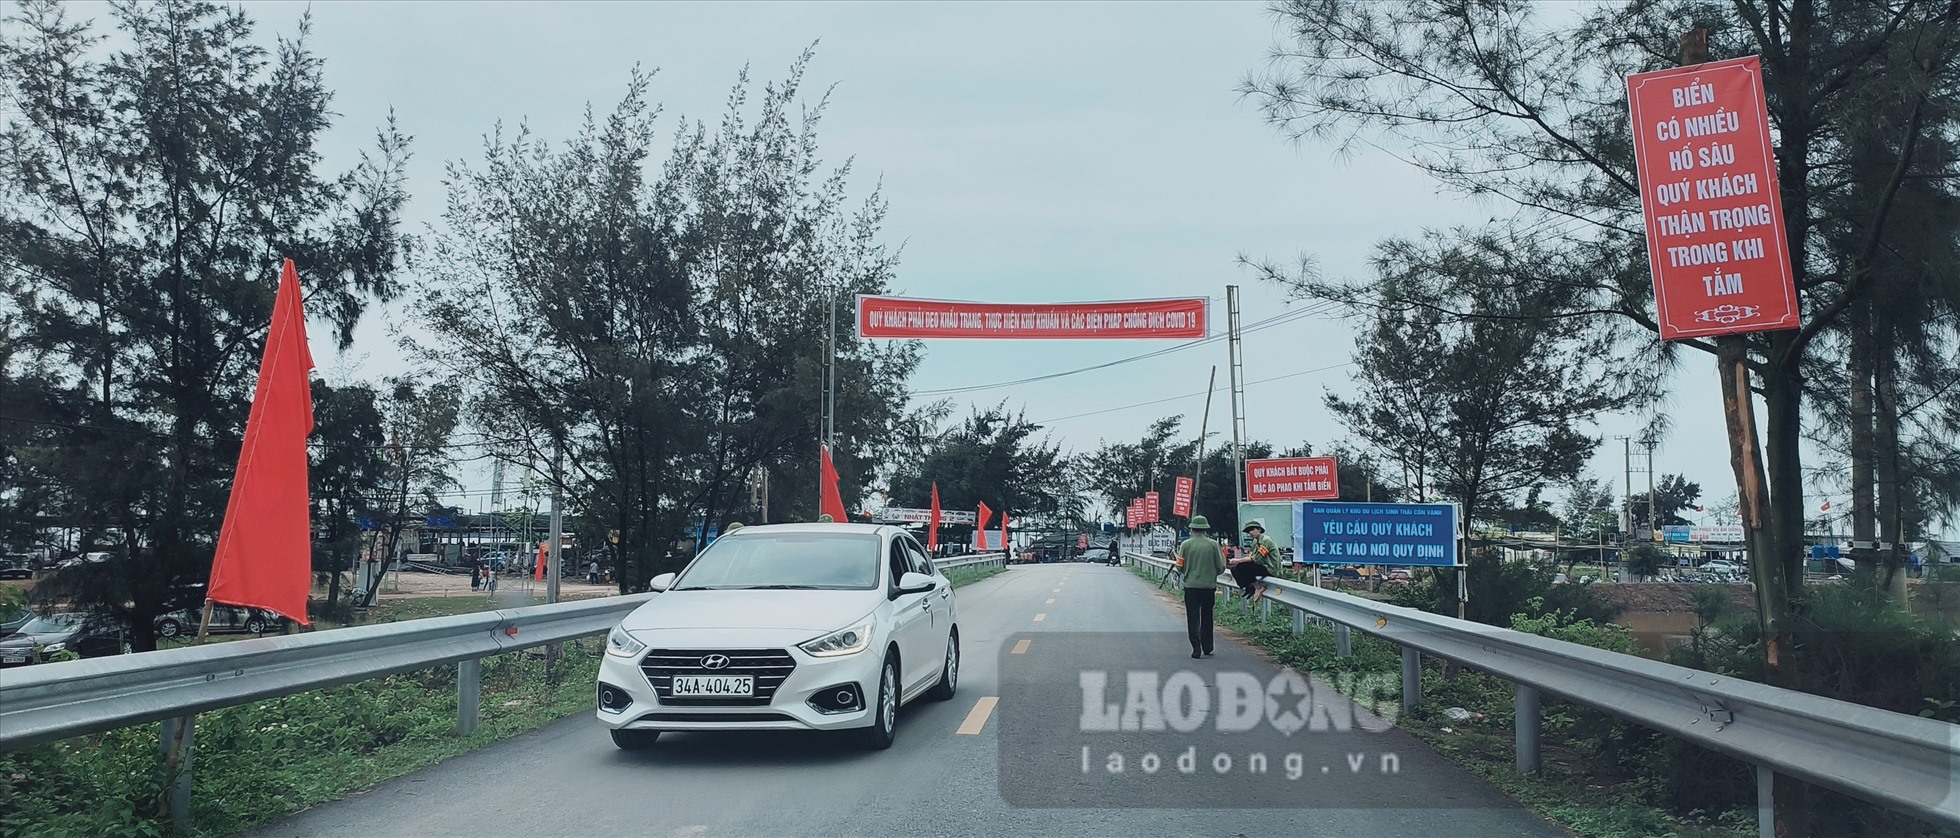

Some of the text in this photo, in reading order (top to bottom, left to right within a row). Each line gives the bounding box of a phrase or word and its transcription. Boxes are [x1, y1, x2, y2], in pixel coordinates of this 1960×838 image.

[1672, 76, 1715, 109] BIỂN
[1656, 106, 1740, 142] CÓ NHIỀU
[1669, 141, 1736, 172] HỐ SÂU
[1656, 172, 1758, 207] QUÝ KHÁCH
[1657, 203, 1772, 239] THẬN TRỌNG
[1668, 237, 1765, 268] TRONG KHI
[1702, 266, 1744, 297] TẮM
[869, 308, 883, 329] QUÝ
[884, 308, 907, 328] KHÁCH
[907, 306, 925, 328] PHẢI
[940, 306, 959, 328] KHẨU
[960, 312, 984, 330] TRANG,
[984, 310, 1003, 332] THỰC
[1003, 309, 1020, 333] HIỆN
[1020, 309, 1036, 329] KHỬ
[1036, 307, 1060, 330] KHUẨN
[1060, 309, 1070, 330] VÀ
[1071, 309, 1086, 329] CÁC
[1086, 309, 1103, 333] BIỆN
[1103, 309, 1122, 329] PHÁP
[1123, 307, 1147, 329] CHỐNG
[1148, 311, 1165, 332] DỊCH
[1165, 311, 1186, 329] COVID
[1187, 311, 1196, 329] 19
[1253, 462, 1329, 479] QUÝ KHÁCH BẮT BUỘC PHẢI
[1253, 478, 1332, 496] MẶC ÁO PHAO KHI TẮM BIỂN
[1322, 517, 1433, 538] YÊU CẦU QUÝ KHÁCH
[1312, 537, 1445, 562] ĐỂ XE VÀO NƠI QUY ĐỊNH
[675, 678, 751, 694] 34A-404.25
